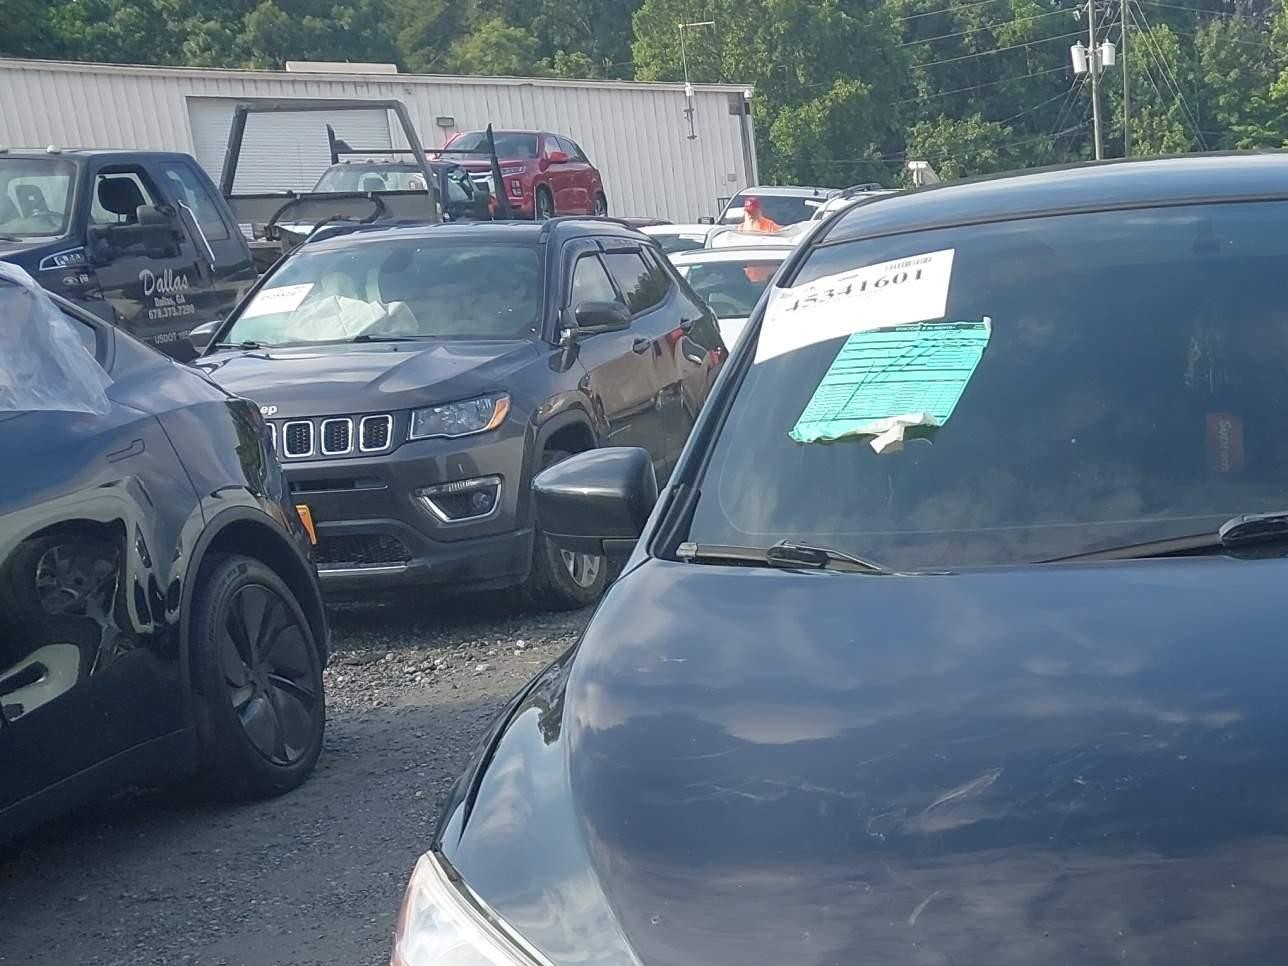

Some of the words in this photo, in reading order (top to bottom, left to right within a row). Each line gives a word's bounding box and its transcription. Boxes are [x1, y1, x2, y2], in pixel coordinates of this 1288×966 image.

[138, 268, 189, 296] Dallas
[153, 331, 177, 345] USDOT
[260, 405, 278, 416] ep
